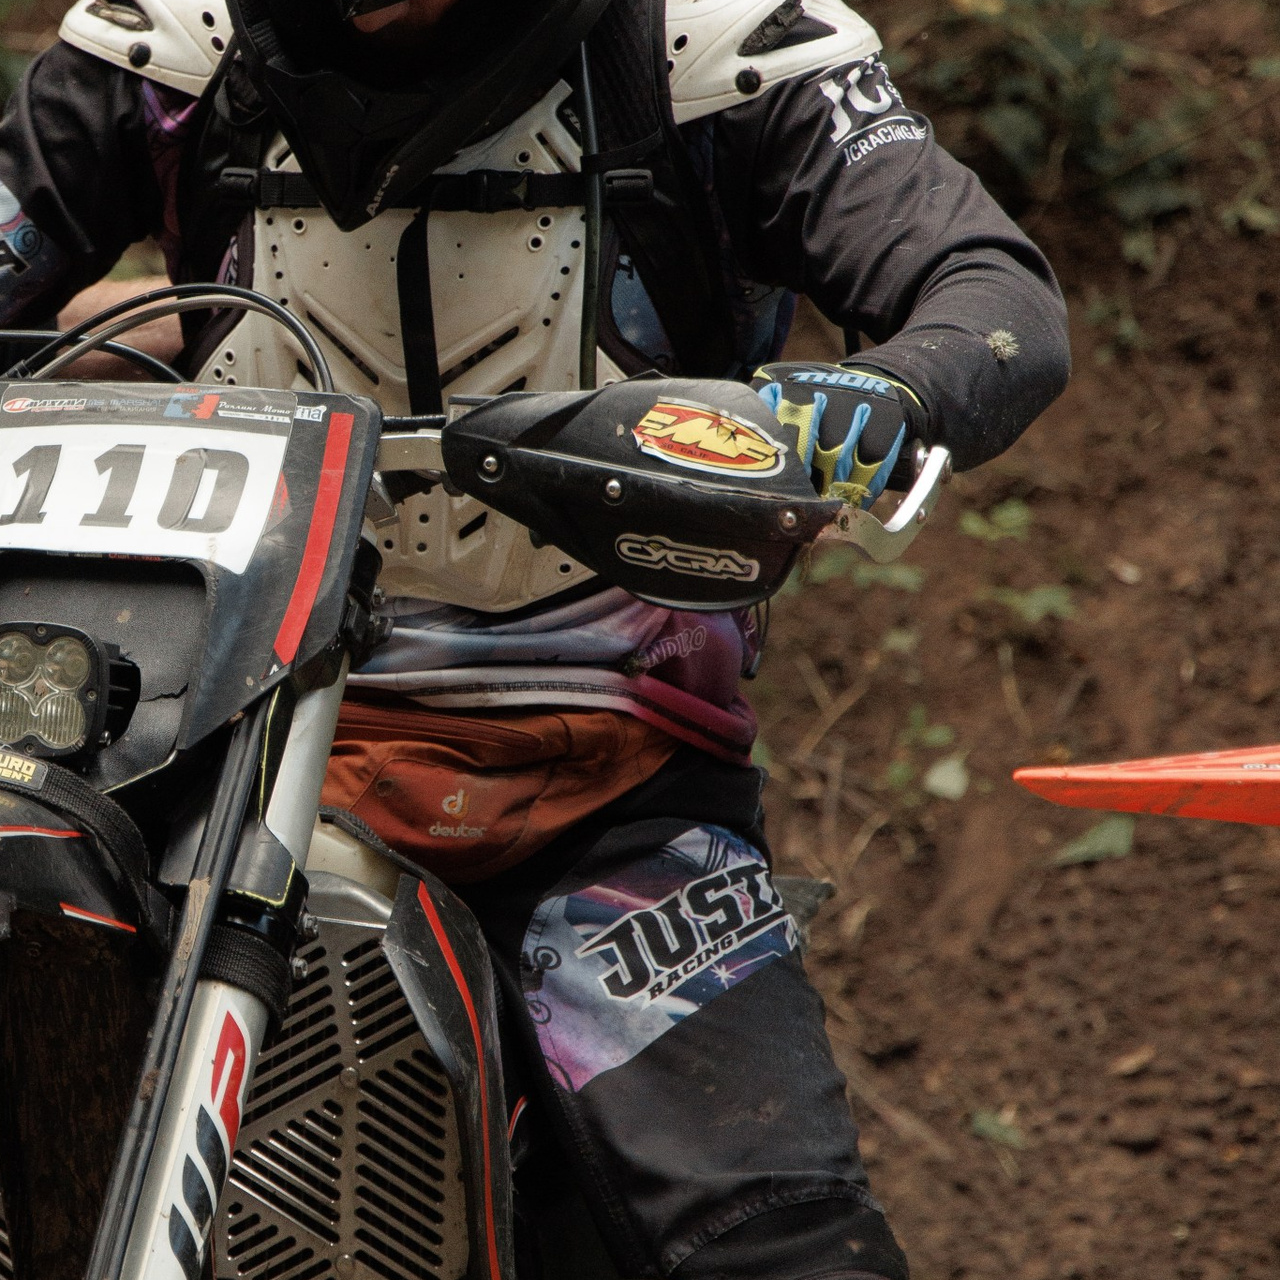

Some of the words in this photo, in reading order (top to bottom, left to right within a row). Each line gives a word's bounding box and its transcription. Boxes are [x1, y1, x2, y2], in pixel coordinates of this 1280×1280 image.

[792, 372, 891, 395] THOR
[637, 409, 781, 462] FMF
[619, 541, 746, 574] CYCRA
[429, 820, 488, 837] deuter
[646, 932, 735, 1002] RACING
